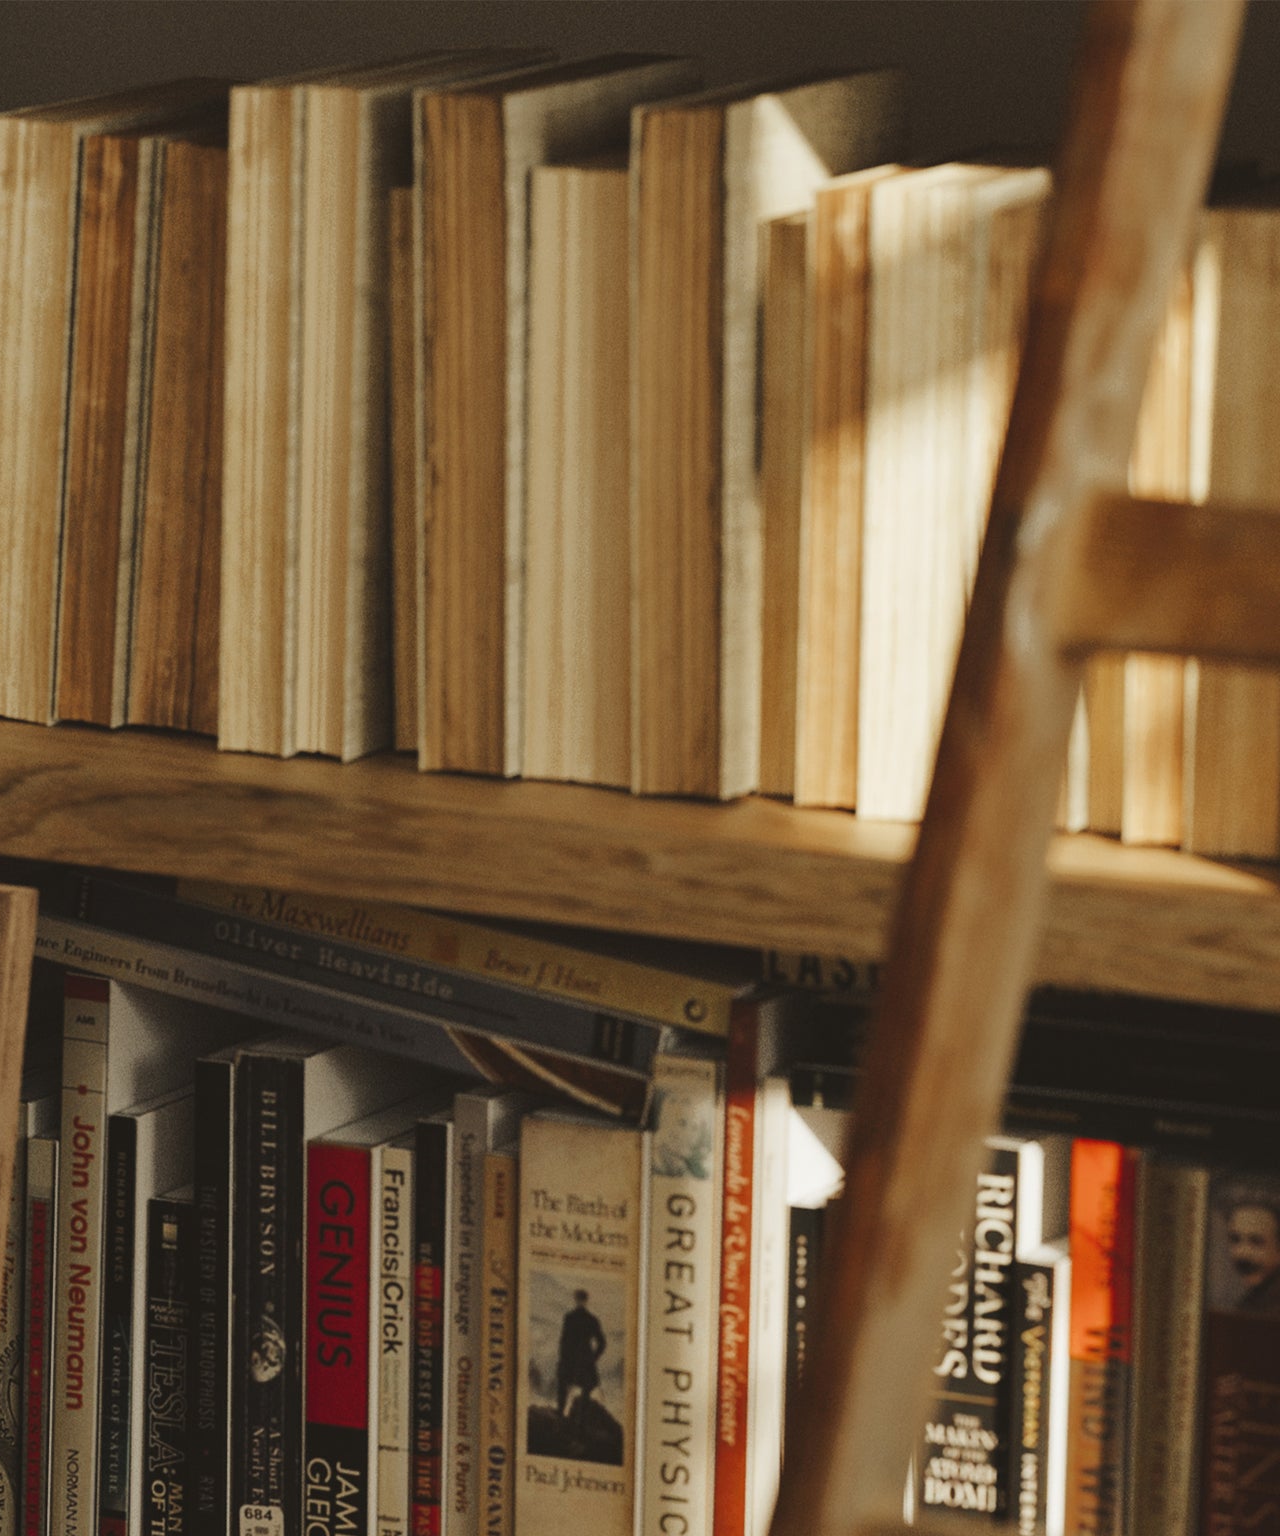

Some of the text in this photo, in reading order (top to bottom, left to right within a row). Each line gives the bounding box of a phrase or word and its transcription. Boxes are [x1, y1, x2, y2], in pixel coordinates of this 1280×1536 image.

[259, 887, 411, 953] Maxwellians
[63, 937, 170, 983] Engineers from
[213, 919, 455, 999] Oliver Heaviside
[258, 1088, 279, 1278] BILL BRYSON
[382, 1167, 406, 1273] Francis
[530, 1188, 562, 1213] The
[566, 1193, 609, 1219] Birth
[64, 1113, 96, 1411] John von Neumann
[453, 1132, 477, 1338] Suspended in Language
[529, 1217, 630, 1248] the Modern
[662, 1190, 697, 1342] GREAT
[316, 1179, 356, 1368] GENIUS
[972, 1172, 1015, 1384] RICHARD
[382, 1281, 405, 1357] Crick
[488, 1284, 509, 1389] FEELING
[197, 1311, 218, 1432] METAMORPHOSIS
[417, 1321, 434, 1412] DISPERSES
[456, 1356, 474, 1437] Ottaviani
[107, 1345, 123, 1495] FORCE OF NATURE
[250, 1423, 267, 1479] Nearly
[417, 1419, 433, 1452] AND
[63, 1447, 81, 1521] NORMAN
[150, 1479, 166, 1512] OF
[167, 1481, 184, 1531] MAN
[267, 1446, 283, 1491] Short
[416, 1460, 432, 1499] TIME
[454, 1462, 472, 1515] Purvis
[525, 1463, 627, 1496] Paul Johnson
[244, 1507, 273, 1522] 684
